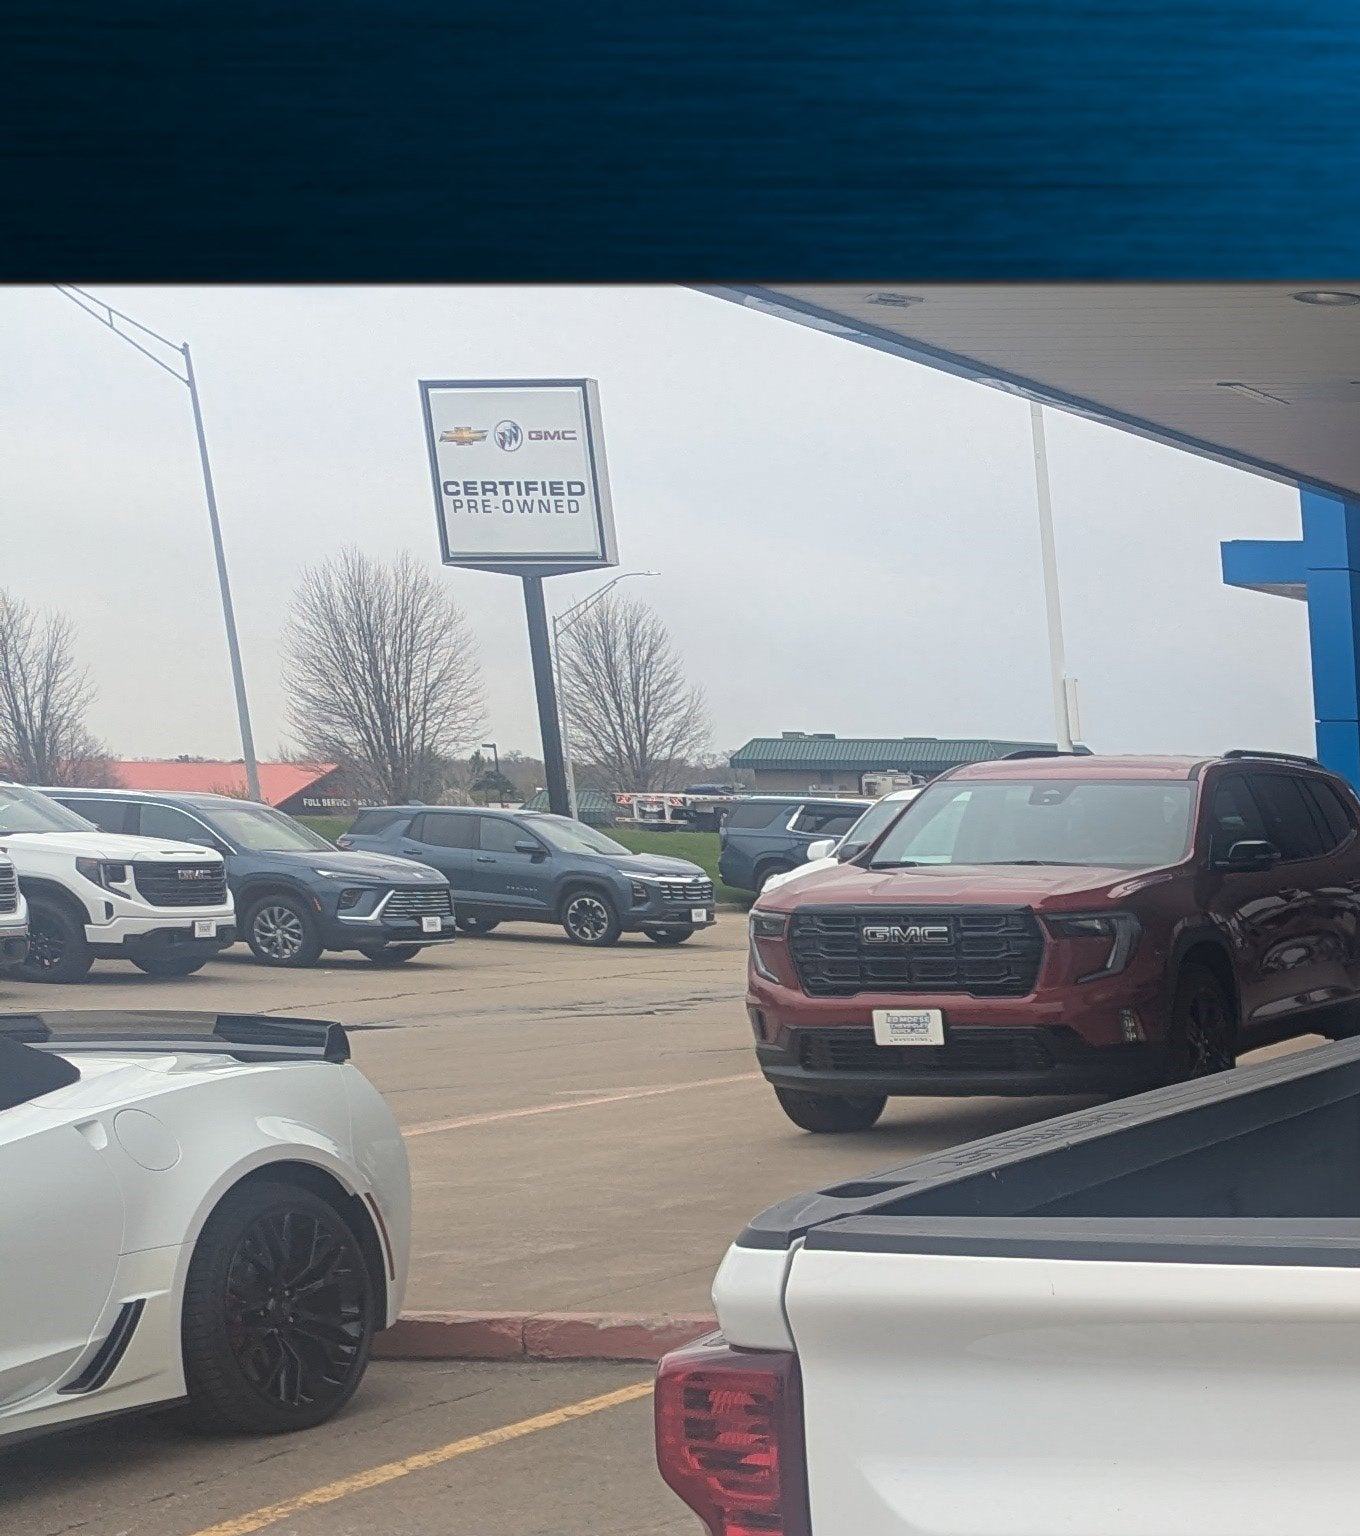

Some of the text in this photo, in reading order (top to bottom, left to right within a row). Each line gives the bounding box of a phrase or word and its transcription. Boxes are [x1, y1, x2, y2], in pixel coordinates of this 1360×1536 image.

[527, 429, 578, 442] GMC
[442, 480, 586, 497] CERTIFIED
[452, 498, 581, 515] PRE-OWNED
[862, 925, 949, 944] GMC
